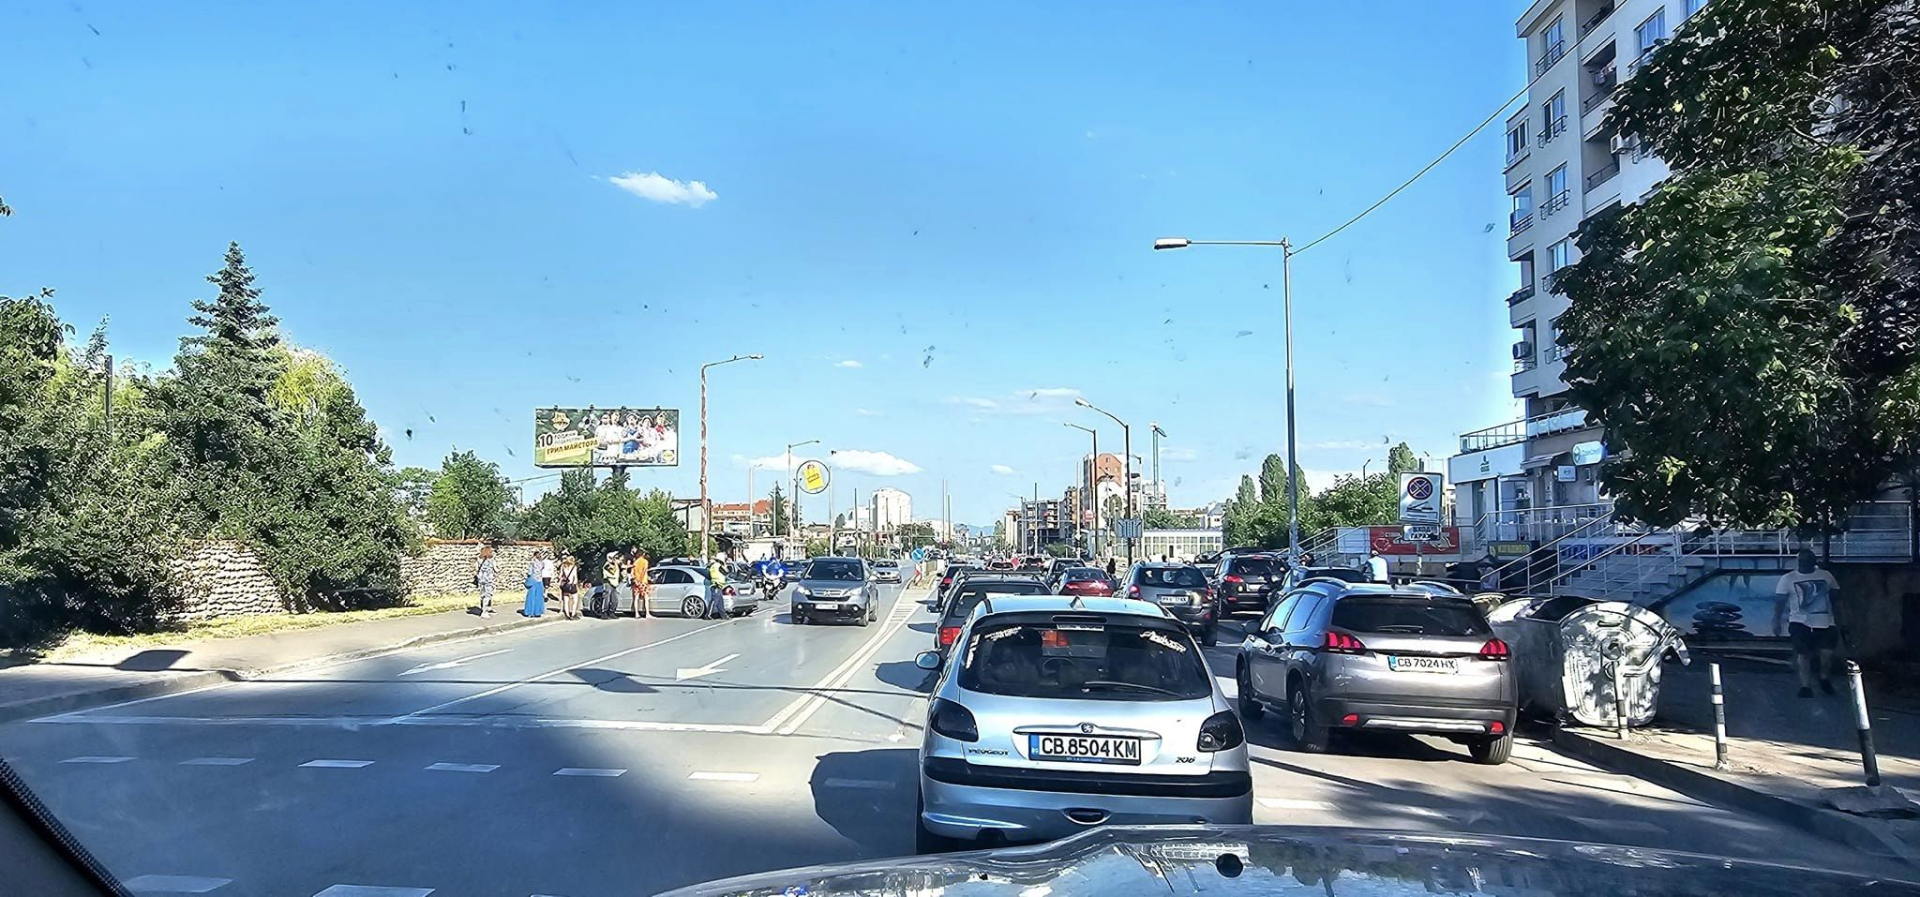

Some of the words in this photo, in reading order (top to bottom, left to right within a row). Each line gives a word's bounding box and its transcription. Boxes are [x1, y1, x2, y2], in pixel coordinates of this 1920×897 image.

[540, 434, 553, 447] 10
[547, 446, 564, 455] ГРИЛ
[564, 439, 598, 451] МАЙСТОРА
[1413, 659, 1439, 669] 7024
[968, 747, 1009, 756] PEUGEOT
